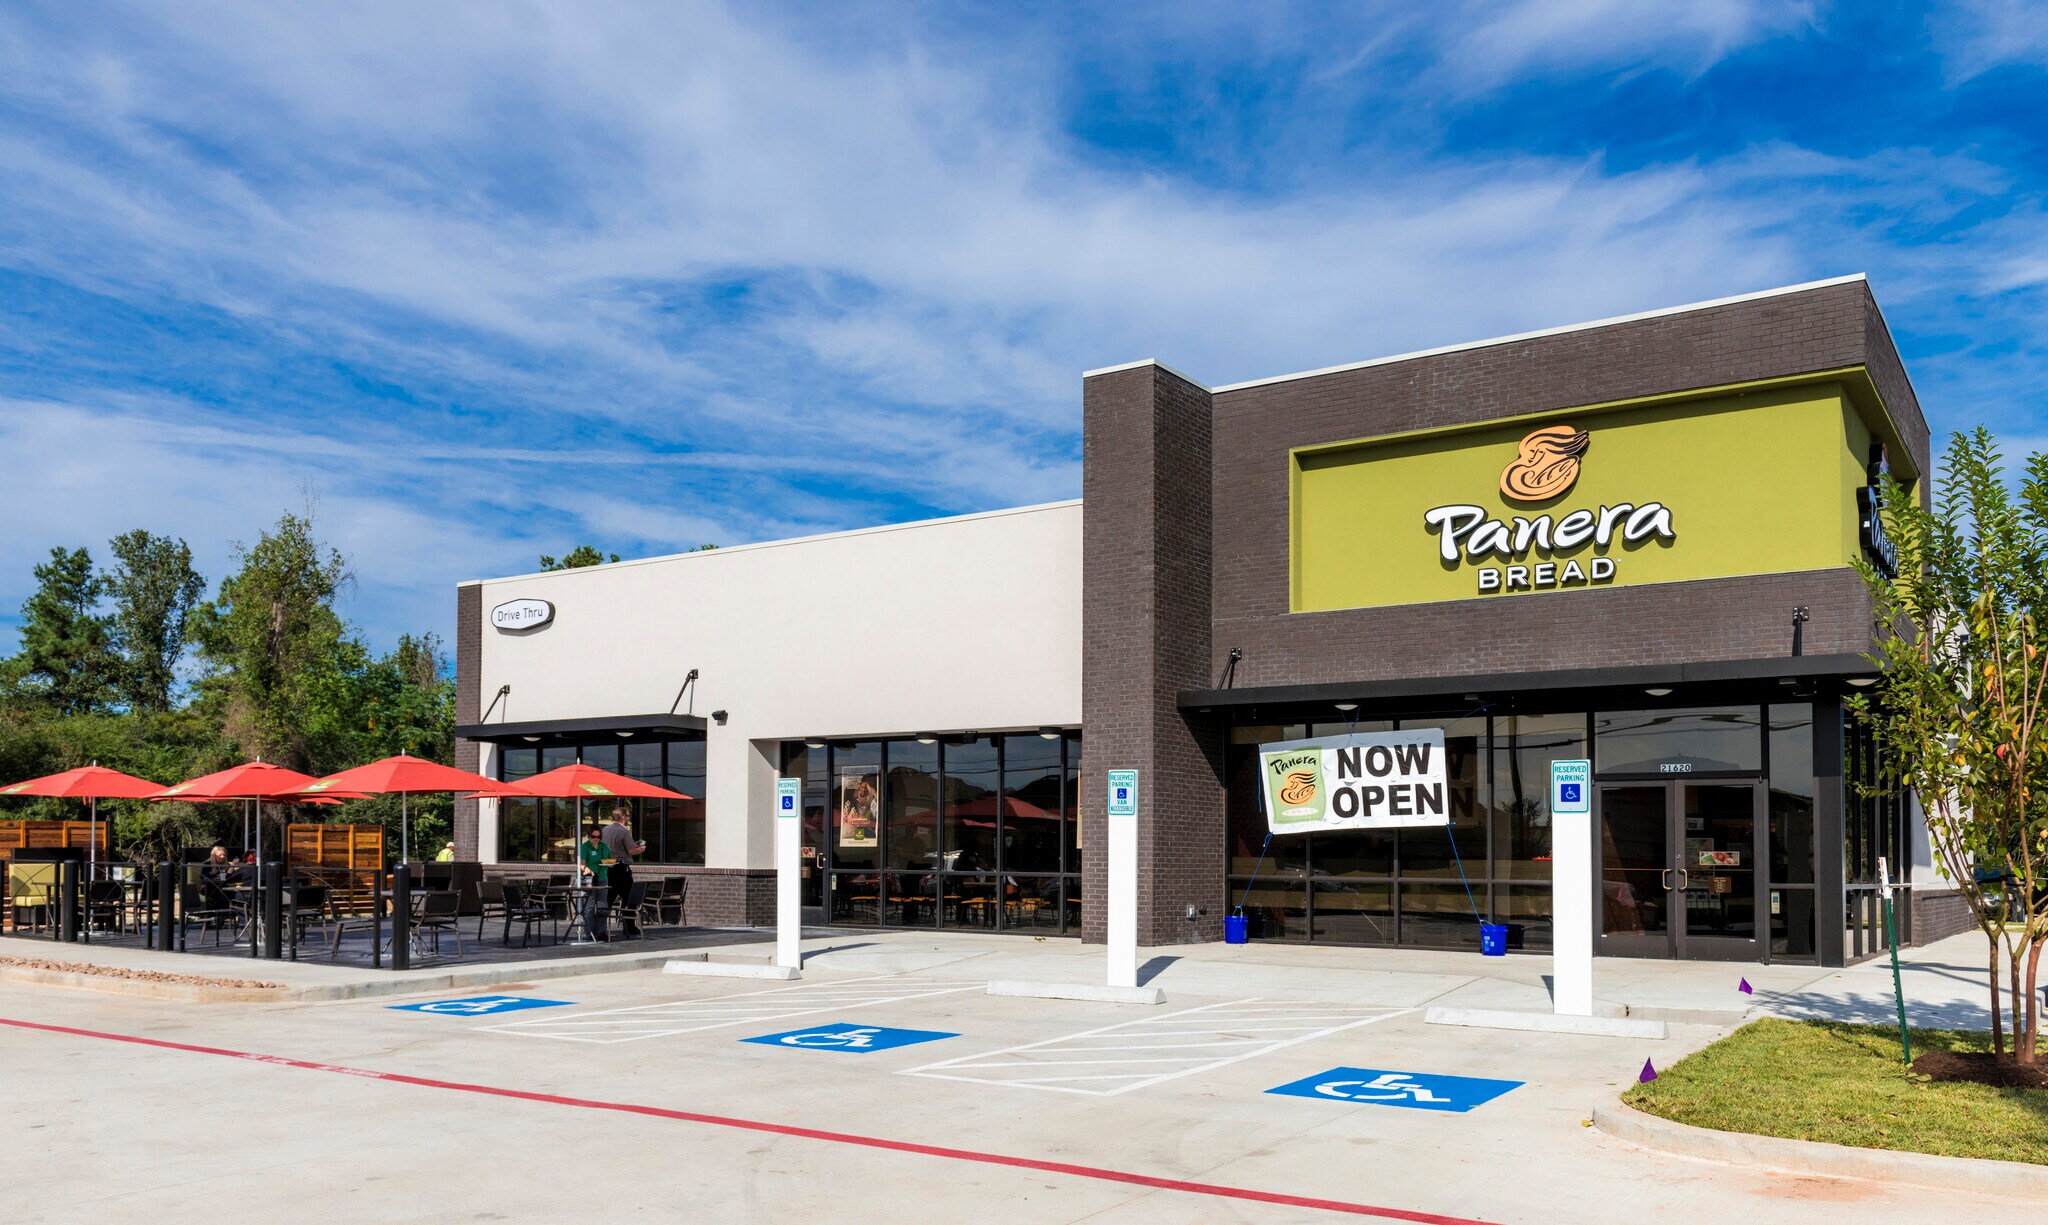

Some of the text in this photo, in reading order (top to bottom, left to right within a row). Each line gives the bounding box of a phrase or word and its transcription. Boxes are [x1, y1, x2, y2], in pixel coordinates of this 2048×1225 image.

[1424, 502, 1677, 561] Panera
[1478, 557, 1616, 590] BREAD
[497, 607, 543, 622] Drive Thru
[1270, 755, 1317, 775] Panera
[1336, 743, 1432, 779] NOW
[1661, 764, 1691, 772] 21620
[1556, 774, 1585, 782] PARKING
[1332, 783, 1444, 818] OPEN
